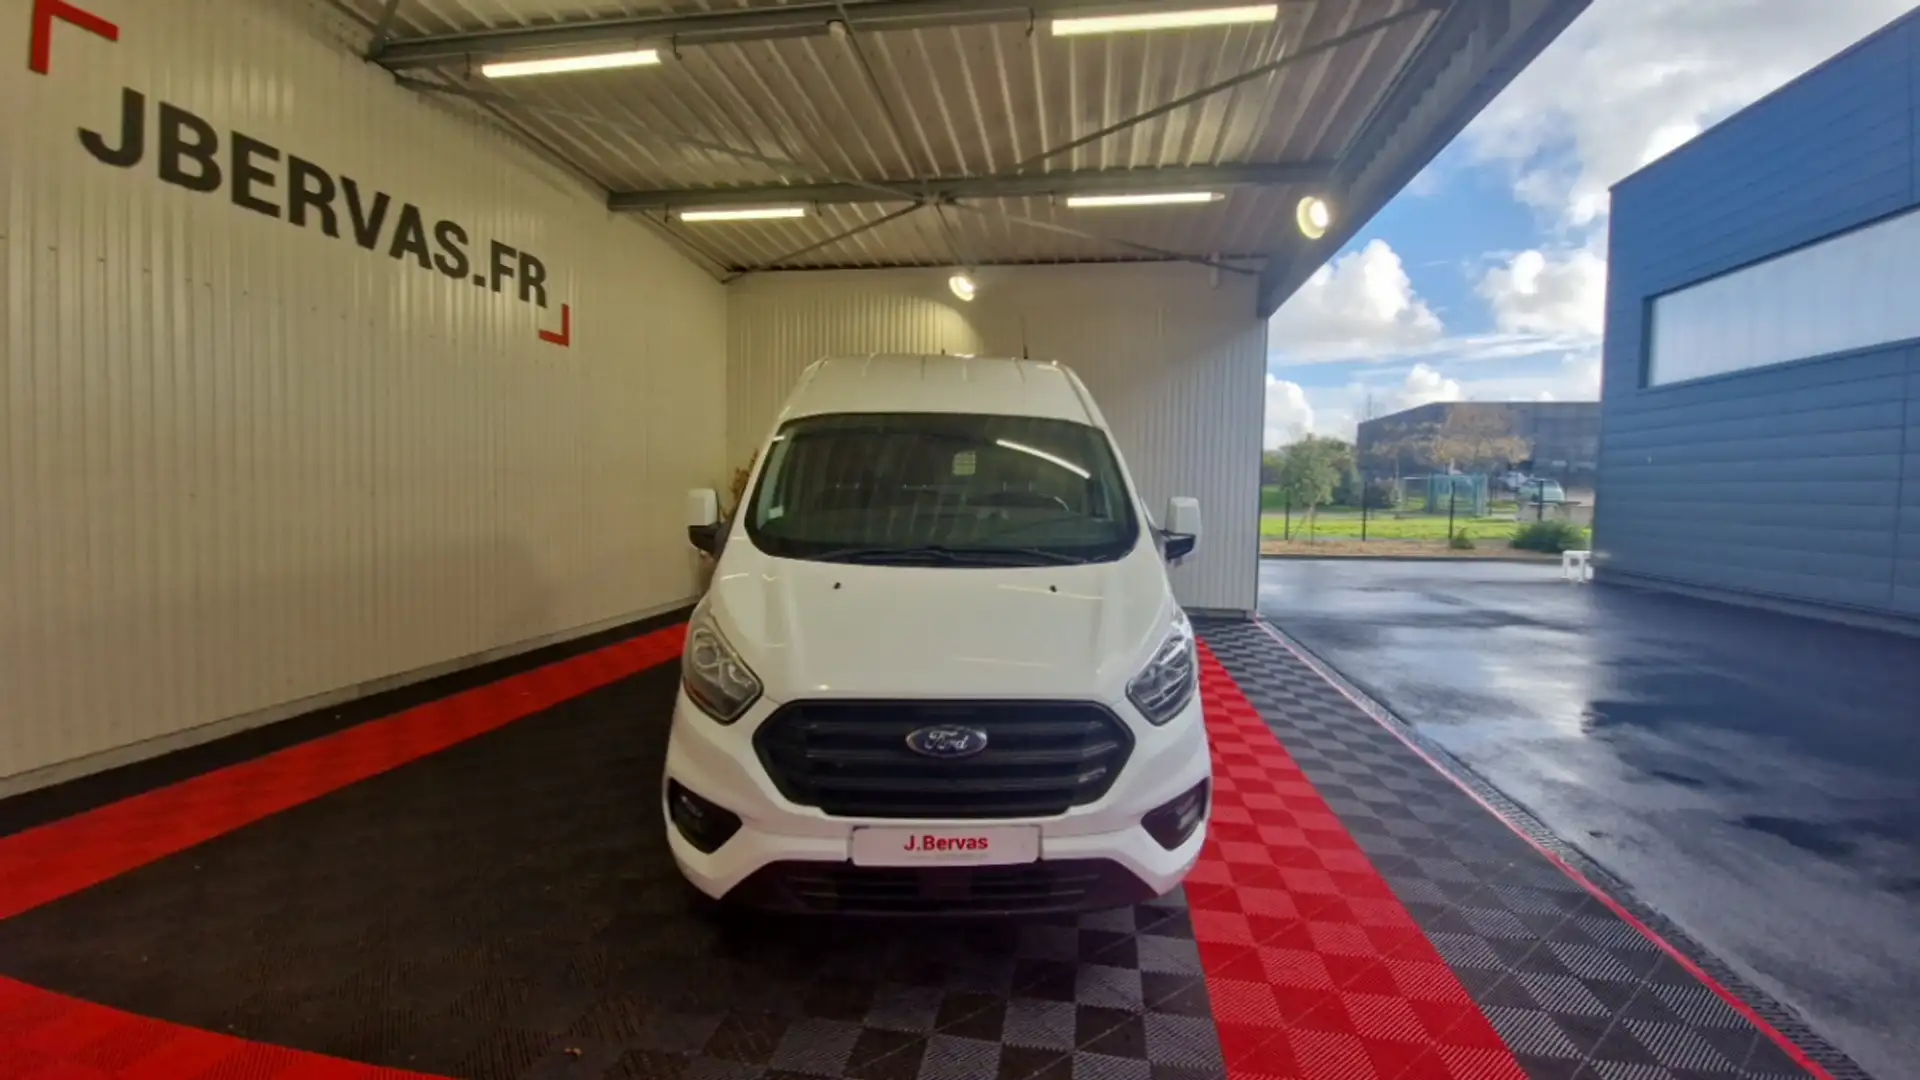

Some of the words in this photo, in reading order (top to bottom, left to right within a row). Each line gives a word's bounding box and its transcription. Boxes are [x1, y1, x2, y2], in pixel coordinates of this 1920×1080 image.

[77, 86, 548, 308] JBERVAS.FR
[924, 731, 970, 750] Ford
[904, 835, 989, 851] J.Bervas
